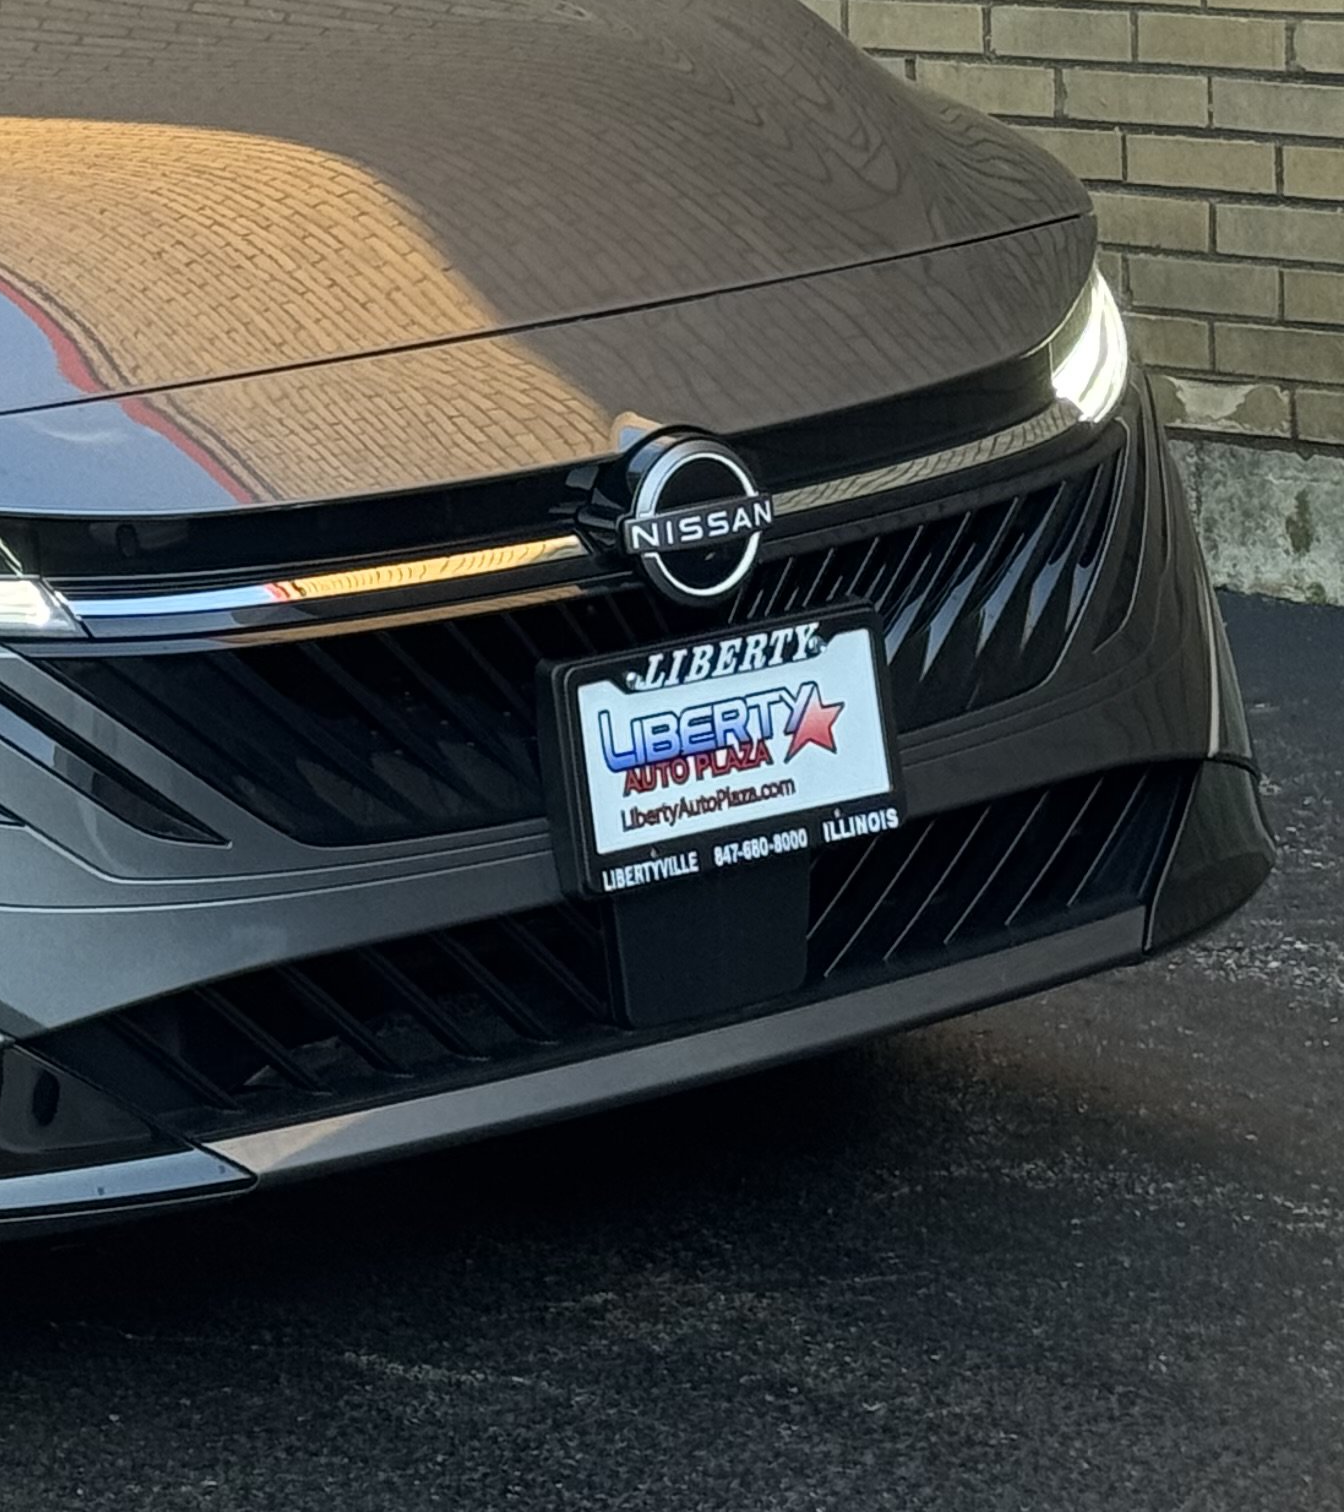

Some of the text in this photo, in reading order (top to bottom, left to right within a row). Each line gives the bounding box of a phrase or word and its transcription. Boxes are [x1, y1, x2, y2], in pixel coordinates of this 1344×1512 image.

[631, 500, 773, 549] NISSAN
[636, 622, 820, 690] LIBERTY
[597, 681, 818, 773] LIBERTY
[623, 738, 774, 797] AUTO PLAZA
[620, 779, 797, 832] LibertyAutoPlaza.com
[602, 807, 899, 892] LIBERTYVILLE 847-680-8000 ILLINOIS
